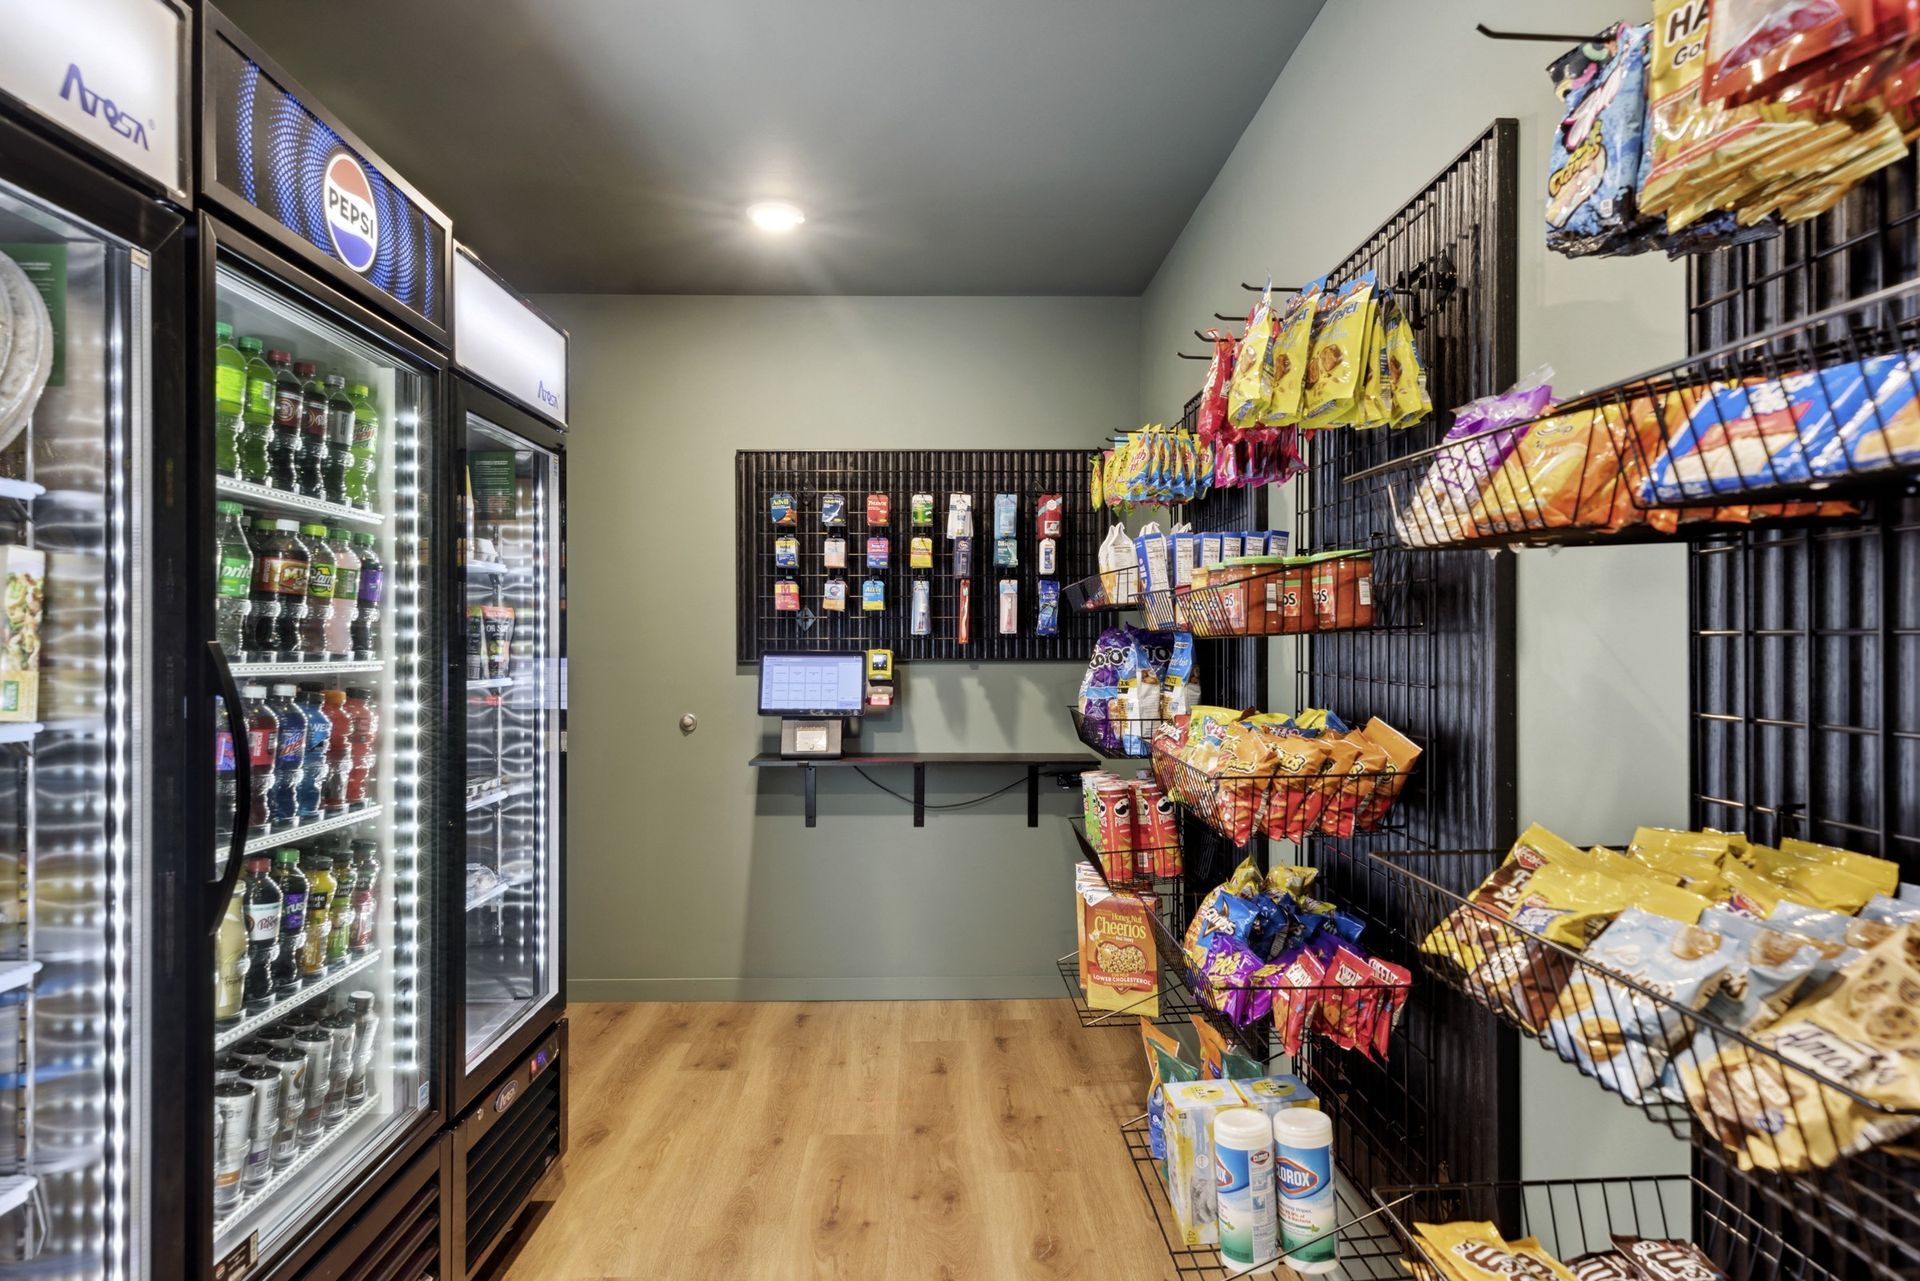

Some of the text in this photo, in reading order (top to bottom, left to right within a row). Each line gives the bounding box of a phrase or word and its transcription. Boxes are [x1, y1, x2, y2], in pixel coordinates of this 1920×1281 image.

[1669, 0, 1708, 42] HA
[1674, 42, 1703, 66] GO
[329, 186, 374, 239] PEPSI
[772, 498, 789, 506] Advil
[222, 563, 250, 580] prit
[1094, 915, 1147, 939] Cheerios
[1111, 912, 1143, 924] Honey Nut
[1093, 973, 1152, 986] LOWER CHOLESTEROL
[1276, 1163, 1310, 1187] LOROX
